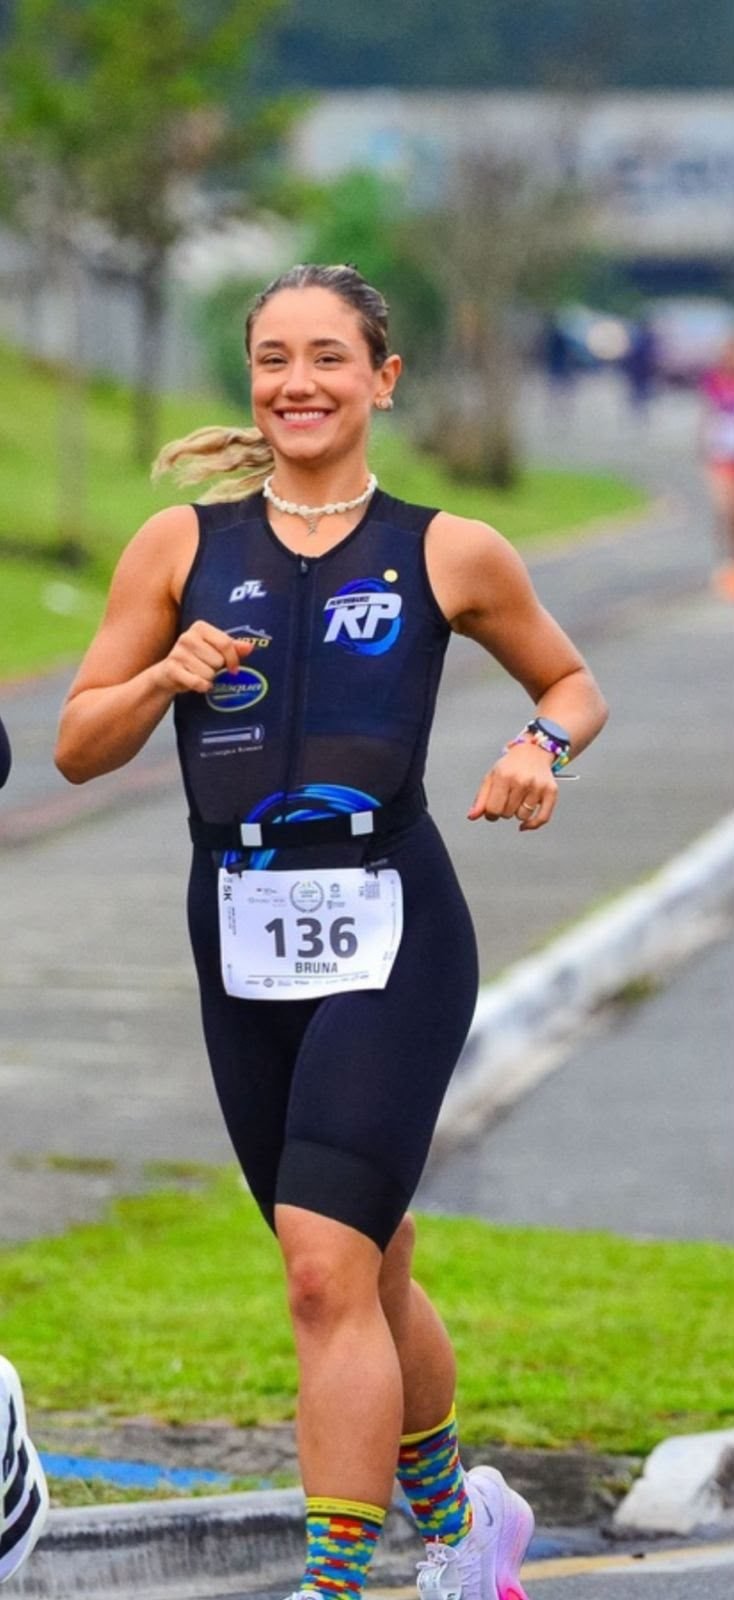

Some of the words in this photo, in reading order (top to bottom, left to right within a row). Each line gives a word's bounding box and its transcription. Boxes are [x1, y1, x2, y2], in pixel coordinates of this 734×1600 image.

[323, 592, 402, 643] RP
[223, 885, 232, 901] 5K
[264, 917, 358, 958] 136
[295, 962, 338, 974] BRUNA
